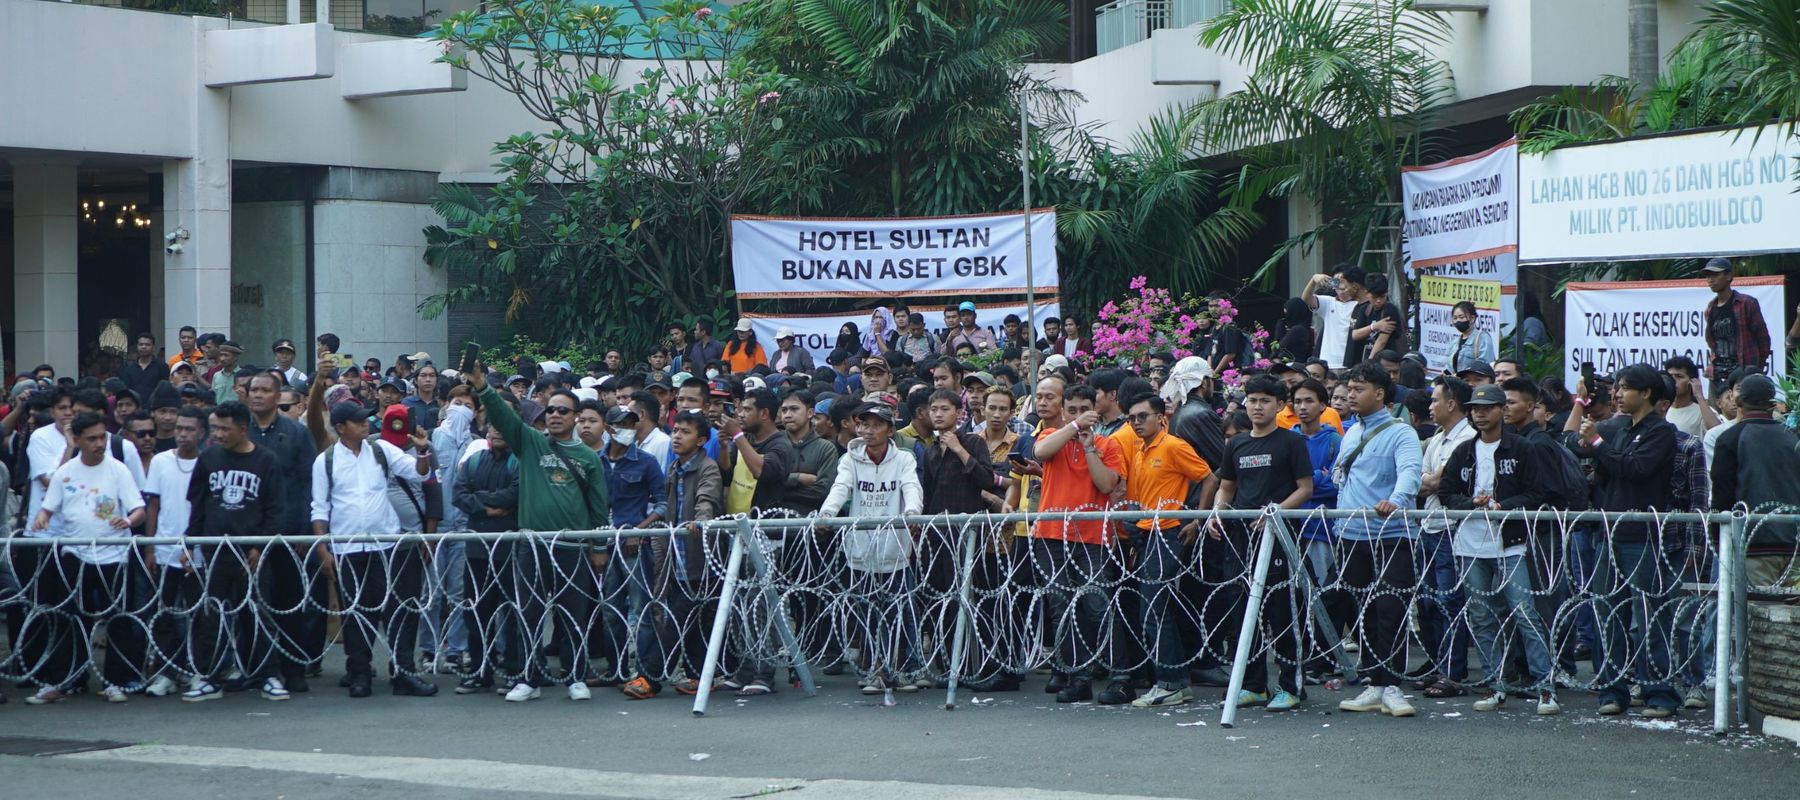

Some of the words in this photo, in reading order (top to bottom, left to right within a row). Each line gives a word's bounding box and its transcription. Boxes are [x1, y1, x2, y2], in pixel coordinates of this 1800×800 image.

[1531, 175, 1583, 204] LAHAN
[1588, 173, 1620, 200] HGB
[1624, 170, 1648, 198] NO
[1652, 168, 1671, 195] 26
[1676, 163, 1712, 193] DAN
[1718, 159, 1754, 188] HGB
[1760, 154, 1786, 184] NO
[1569, 208, 1612, 236] MILIK
[1617, 206, 1640, 233] PT.
[1646, 195, 1763, 232] INDOBUILDCO
[799, 229, 883, 252] HOTEL
[889, 227, 990, 250] SULTAN
[782, 259, 872, 281] BUKAN
[879, 257, 947, 279] ASET
[954, 255, 1008, 278] GBK
[1427, 281, 1448, 298] STOP
[1452, 283, 1494, 303] EKSEKUSI
[1584, 312, 1630, 337] TOLAK
[1634, 310, 1704, 337] EKSEKUSI
[209, 470, 261, 498] SMITH
